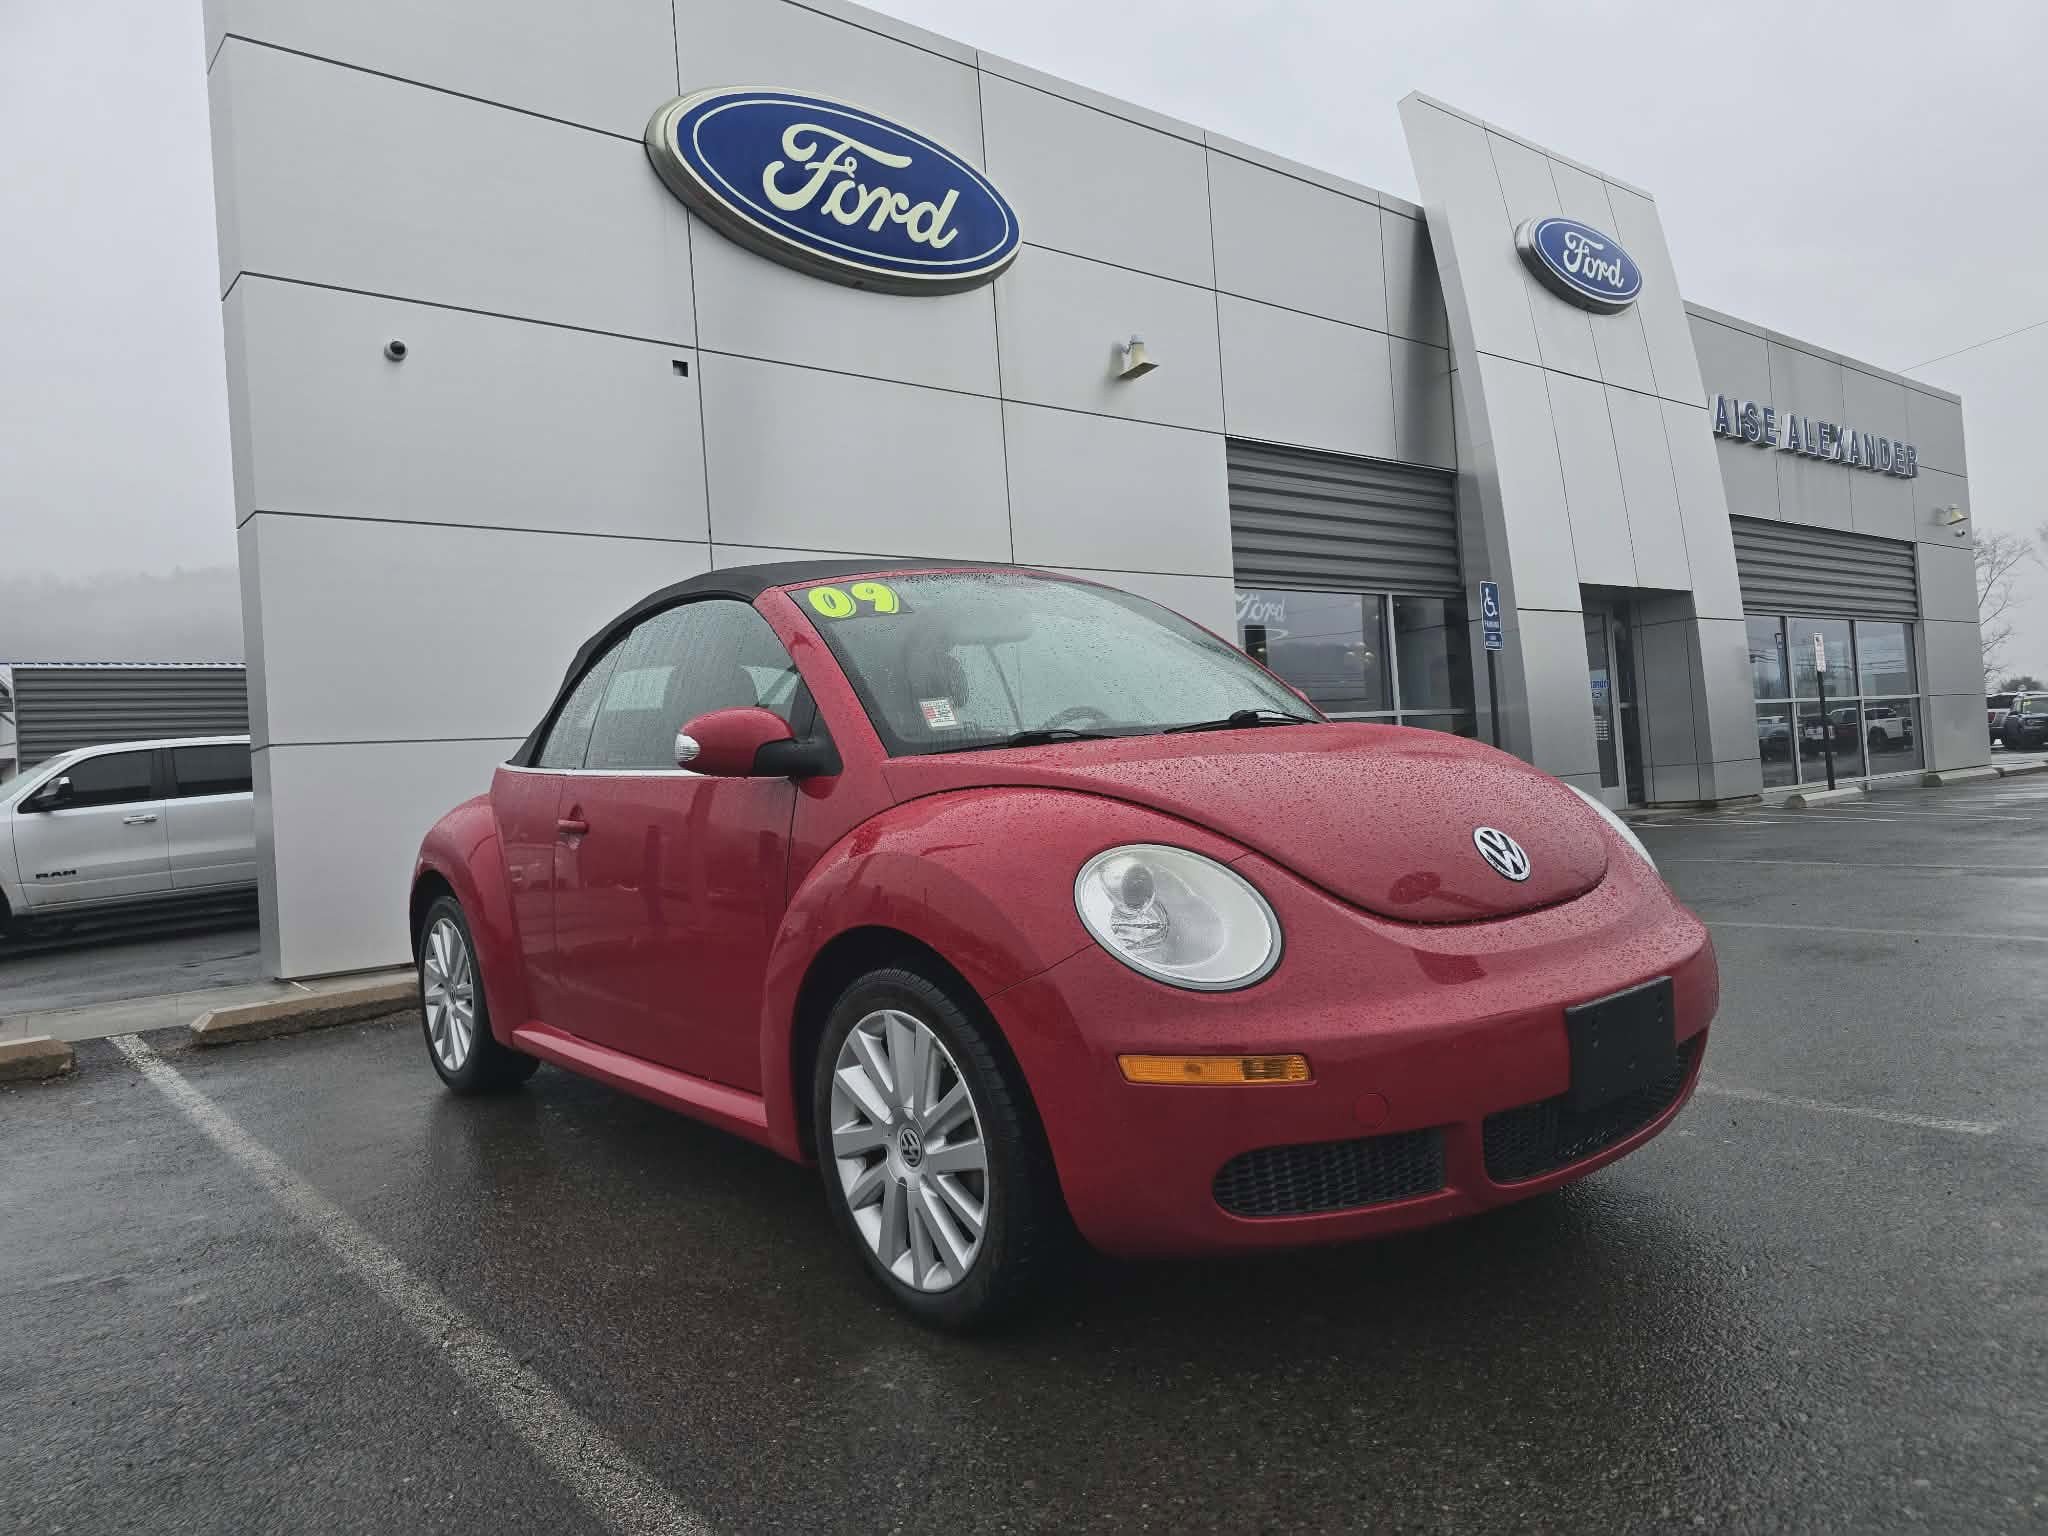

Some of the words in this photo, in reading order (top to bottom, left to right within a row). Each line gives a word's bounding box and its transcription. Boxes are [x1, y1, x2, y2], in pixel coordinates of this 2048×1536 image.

[762, 123, 960, 249] Ford
[1563, 231, 1624, 288] Ford
[1783, 414, 1920, 476] ALEXANDER
[808, 582, 900, 618] 09
[35, 869, 77, 879] RAM
